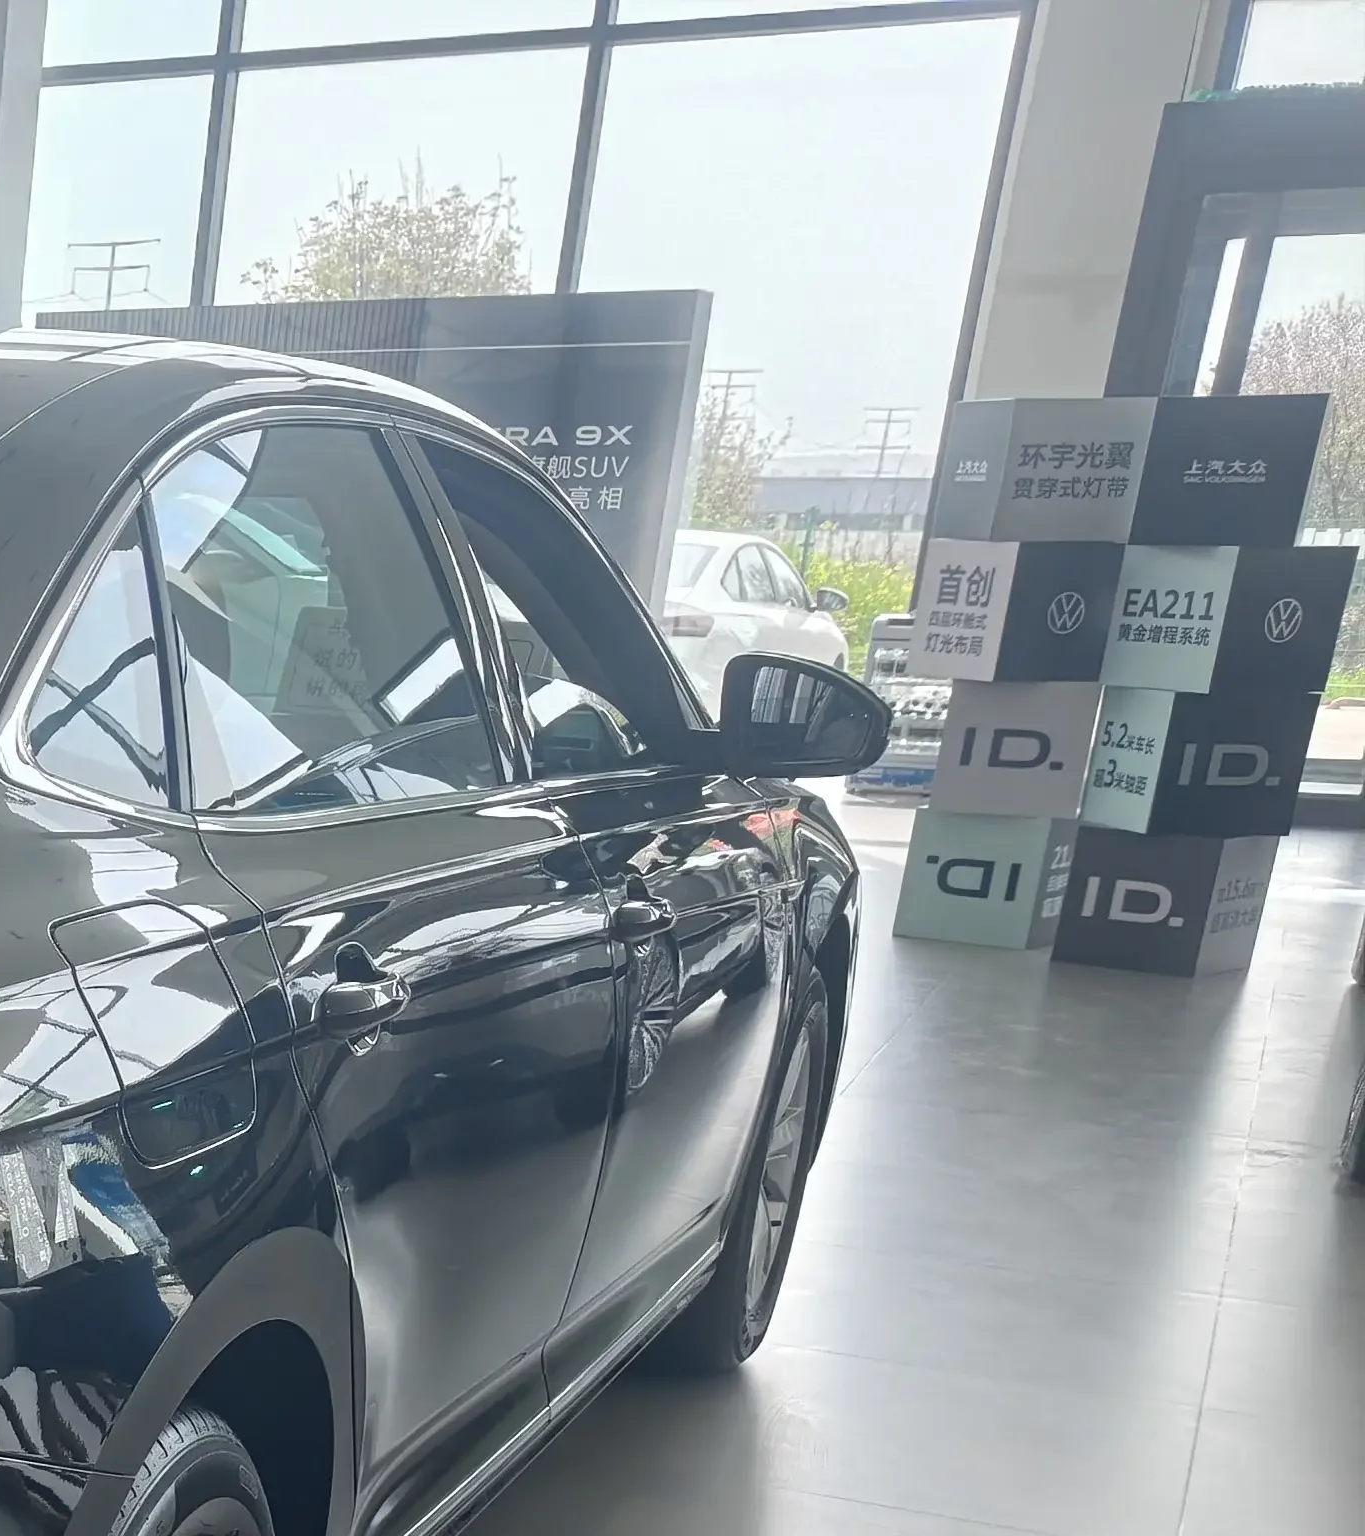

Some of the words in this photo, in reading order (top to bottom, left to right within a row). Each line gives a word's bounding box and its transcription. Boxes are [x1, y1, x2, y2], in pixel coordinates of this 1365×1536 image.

[495, 426, 559, 447] RA
[575, 425, 633, 446] 9X
[1018, 441, 1135, 470] 环宇光翼
[1184, 459, 1268, 474] 上汽大众
[568, 486, 623, 511] 亮相
[1012, 476, 1130, 499] 贯穿式灯带
[936, 564, 996, 608] 首创
[1122, 588, 1214, 621] EA211
[1118, 623, 1211, 647] 黄金增程系统
[959, 726, 1064, 771] ID.
[1177, 743, 1281, 787] ID.
[926, 855, 1022, 901] ID.
[1080, 876, 1184, 927] ID.
